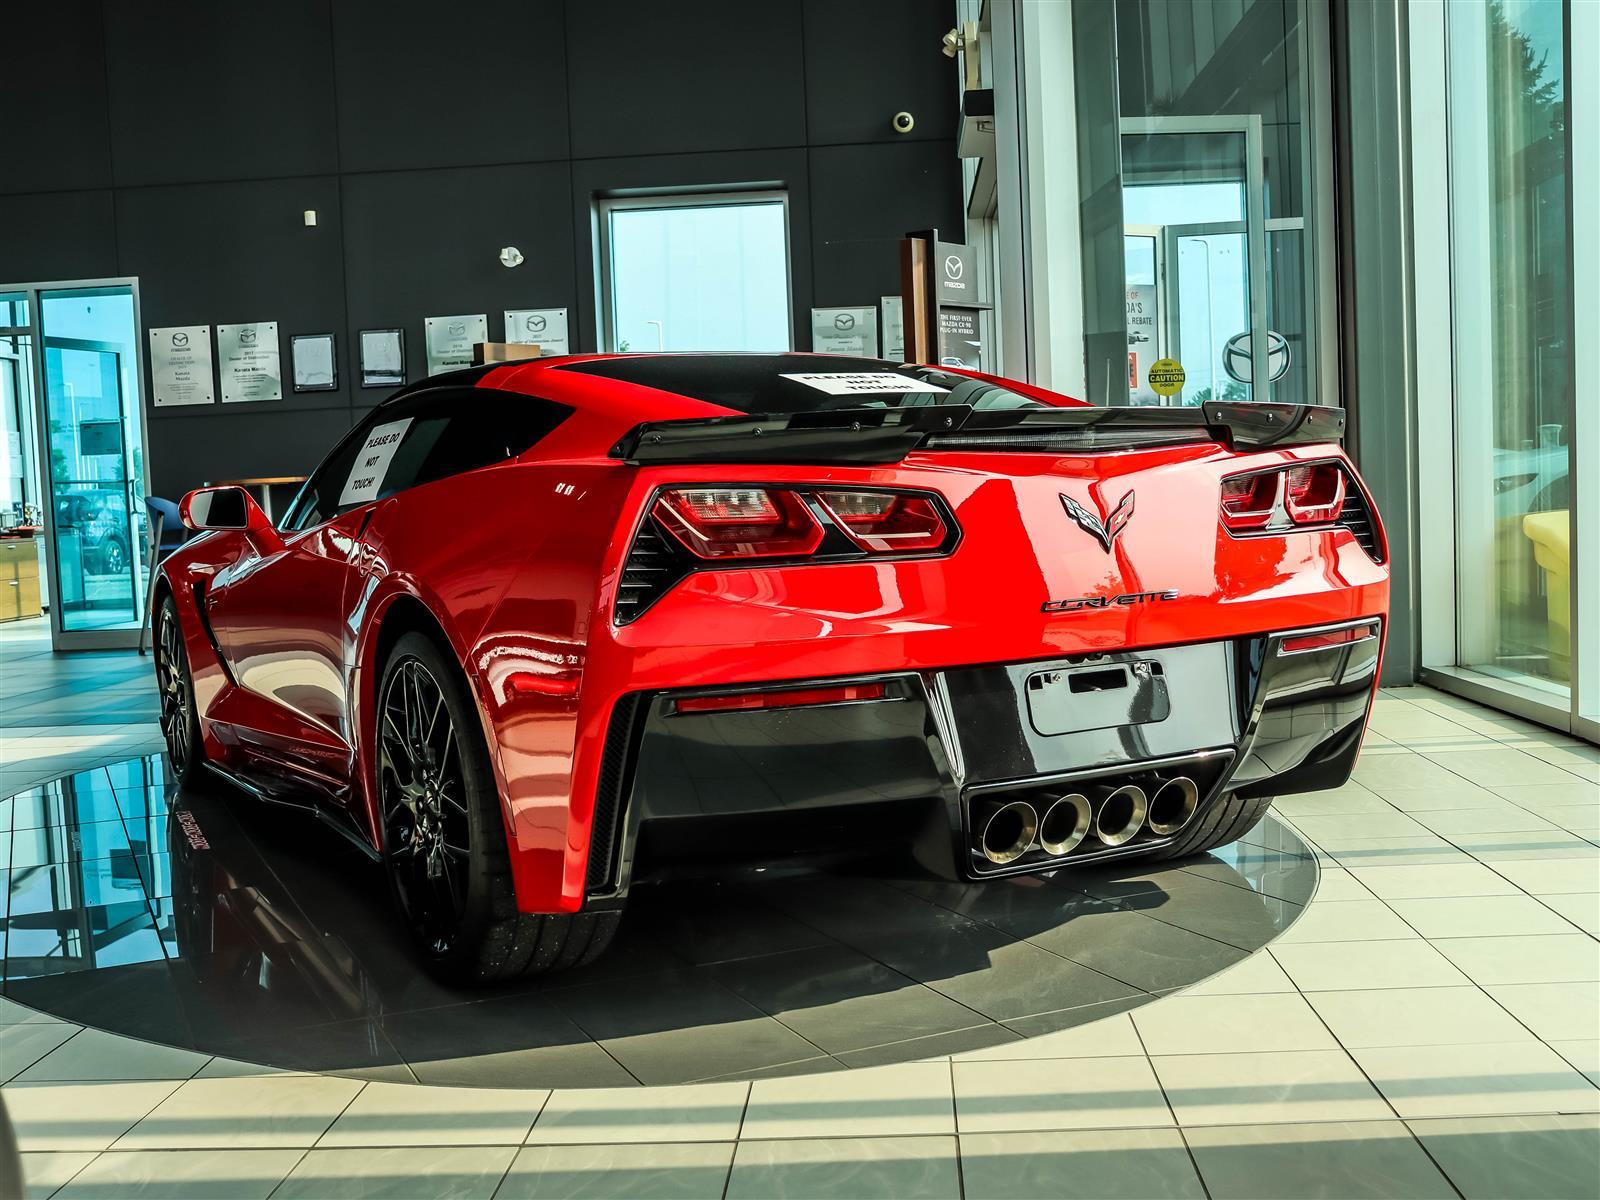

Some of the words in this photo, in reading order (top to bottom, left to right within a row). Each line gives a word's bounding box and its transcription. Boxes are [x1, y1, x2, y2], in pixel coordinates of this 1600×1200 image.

[944, 281, 966, 289] mazda
[1131, 316, 1153, 326] REBATE
[1149, 374, 1184, 382] CAUTION
[366, 434, 391, 449] PLEASE
[388, 432, 401, 444] DO
[365, 455, 381, 468] NOT
[352, 476, 376, 491] TOUCH!
[1040, 588, 1179, 613] CORVETTE
